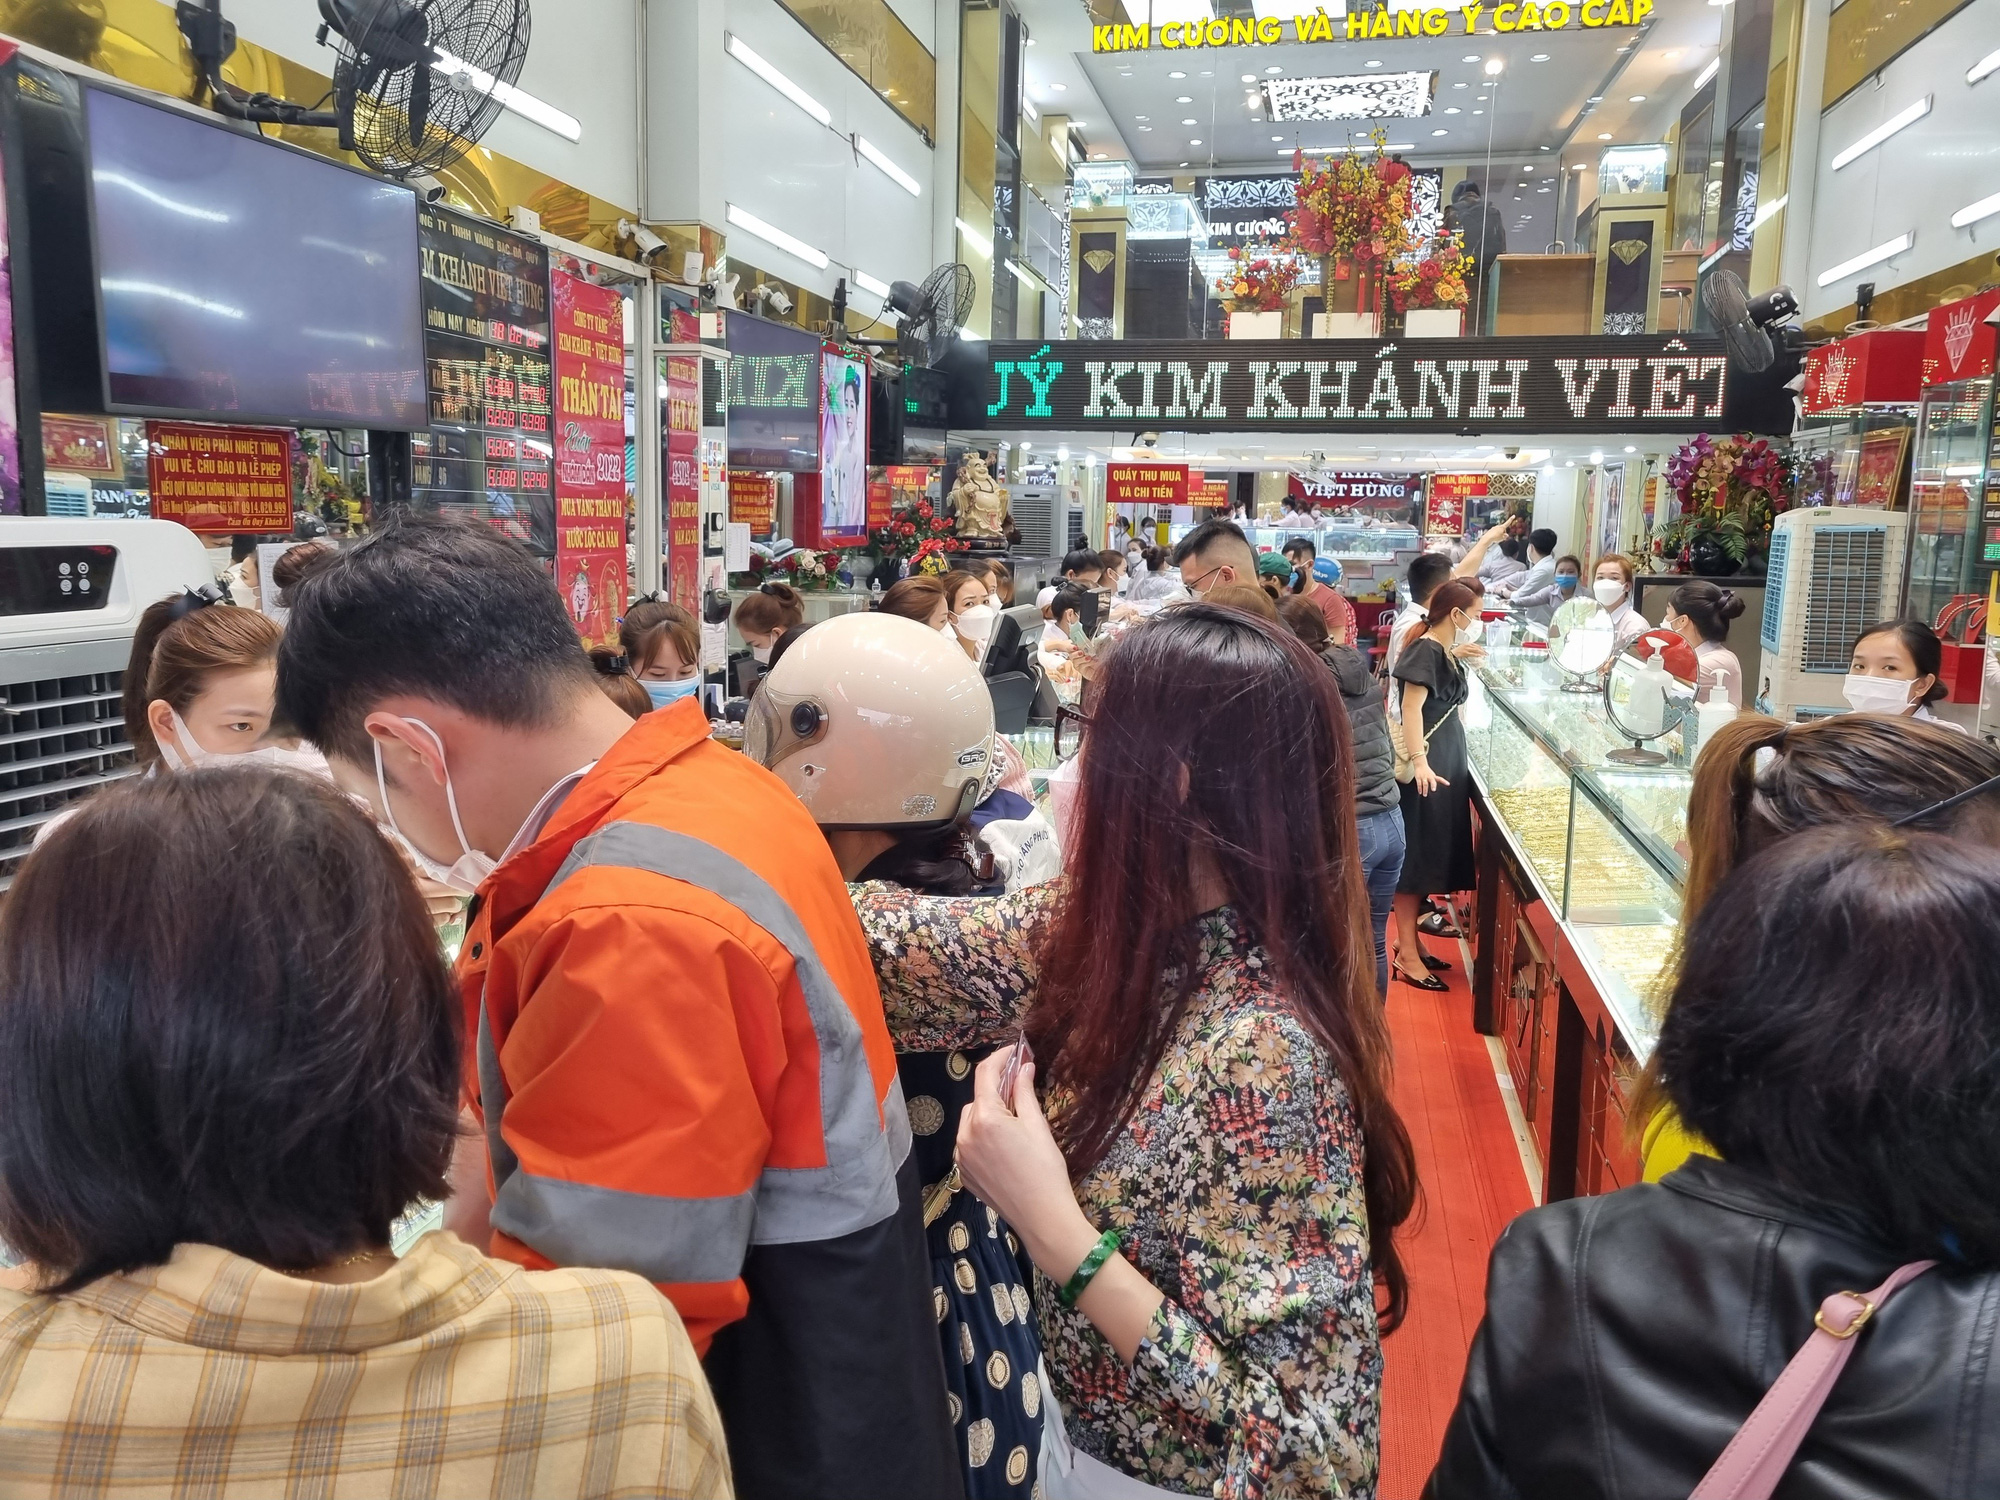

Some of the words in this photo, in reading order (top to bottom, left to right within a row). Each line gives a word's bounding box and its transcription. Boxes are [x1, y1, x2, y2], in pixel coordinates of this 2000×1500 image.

[1093, 23, 1150, 51] KIM
[1159, 16, 1282, 49] CƯƠNG
[1294, 6, 1334, 42] VÀ
[1347, 3, 1449, 39] HÀNG
[1462, 0, 1484, 35] Ý
[1493, 1, 1571, 32] CAO
[437, 218, 448, 233] TY
[451, 223, 472, 242] TNHH
[474, 229, 494, 250] VÀNG
[1206, 222, 1231, 236] KIM
[438, 251, 487, 295] KHÁNH
[488, 267, 514, 307] VIỆT
[515, 273, 545, 313] HÙNG
[427, 306, 446, 329] HÔM
[448, 313, 464, 332] NAY
[466, 316, 486, 338] NGÀY
[573, 307, 587, 329] CÔNG
[587, 313, 594, 331] TY
[595, 314, 608, 334] VÀNG
[559, 332, 571, 353] KIM
[572, 334, 591, 357] KHÁNH
[595, 340, 608, 364] VIỆT
[608, 343, 622, 365] HÙNG
[561, 362, 598, 417] THẦN
[601, 376, 622, 421] TÀI
[1083, 361, 1229, 418] KIM
[1246, 343, 1529, 418] KHÁNH
[161, 433, 188, 451] NHÂN
[190, 434, 210, 452] VIÊN
[213, 435, 233, 454] PHẢI
[235, 439, 258, 457] NHIỆT
[261, 439, 281, 457] TÌNH,
[163, 457, 179, 473] VUI
[181, 453, 195, 474] VẺ,
[197, 457, 215, 474] CHU
[217, 458, 234, 474] ĐÁO
[237, 459, 248, 475] VÀ
[250, 457, 259, 476] LỄ
[261, 460, 282, 477] PHÉP
[597, 453, 621, 482] 2022
[1140, 470, 1157, 481] THU
[1160, 470, 1181, 481] MUA
[161, 476, 173, 496] NẾU
[187, 478, 206, 496] KHÁCH
[206, 479, 225, 497] KHÔNG
[1119, 485, 1131, 498] VÀ
[1134, 486, 1149, 498] CHI
[1303, 483, 1347, 499] VIỆT
[1350, 481, 1405, 498] HÙNG
[561, 497, 576, 516] MUA
[576, 494, 594, 517] VÀNG
[595, 491, 612, 518] THẦN
[612, 495, 622, 518] TÀI
[566, 525, 583, 549] RƯỚC
[584, 525, 596, 553] LỘC
[596, 523, 605, 548] CẢ
[606, 526, 619, 548] NĂM
[961, 753, 986, 763] GRO
